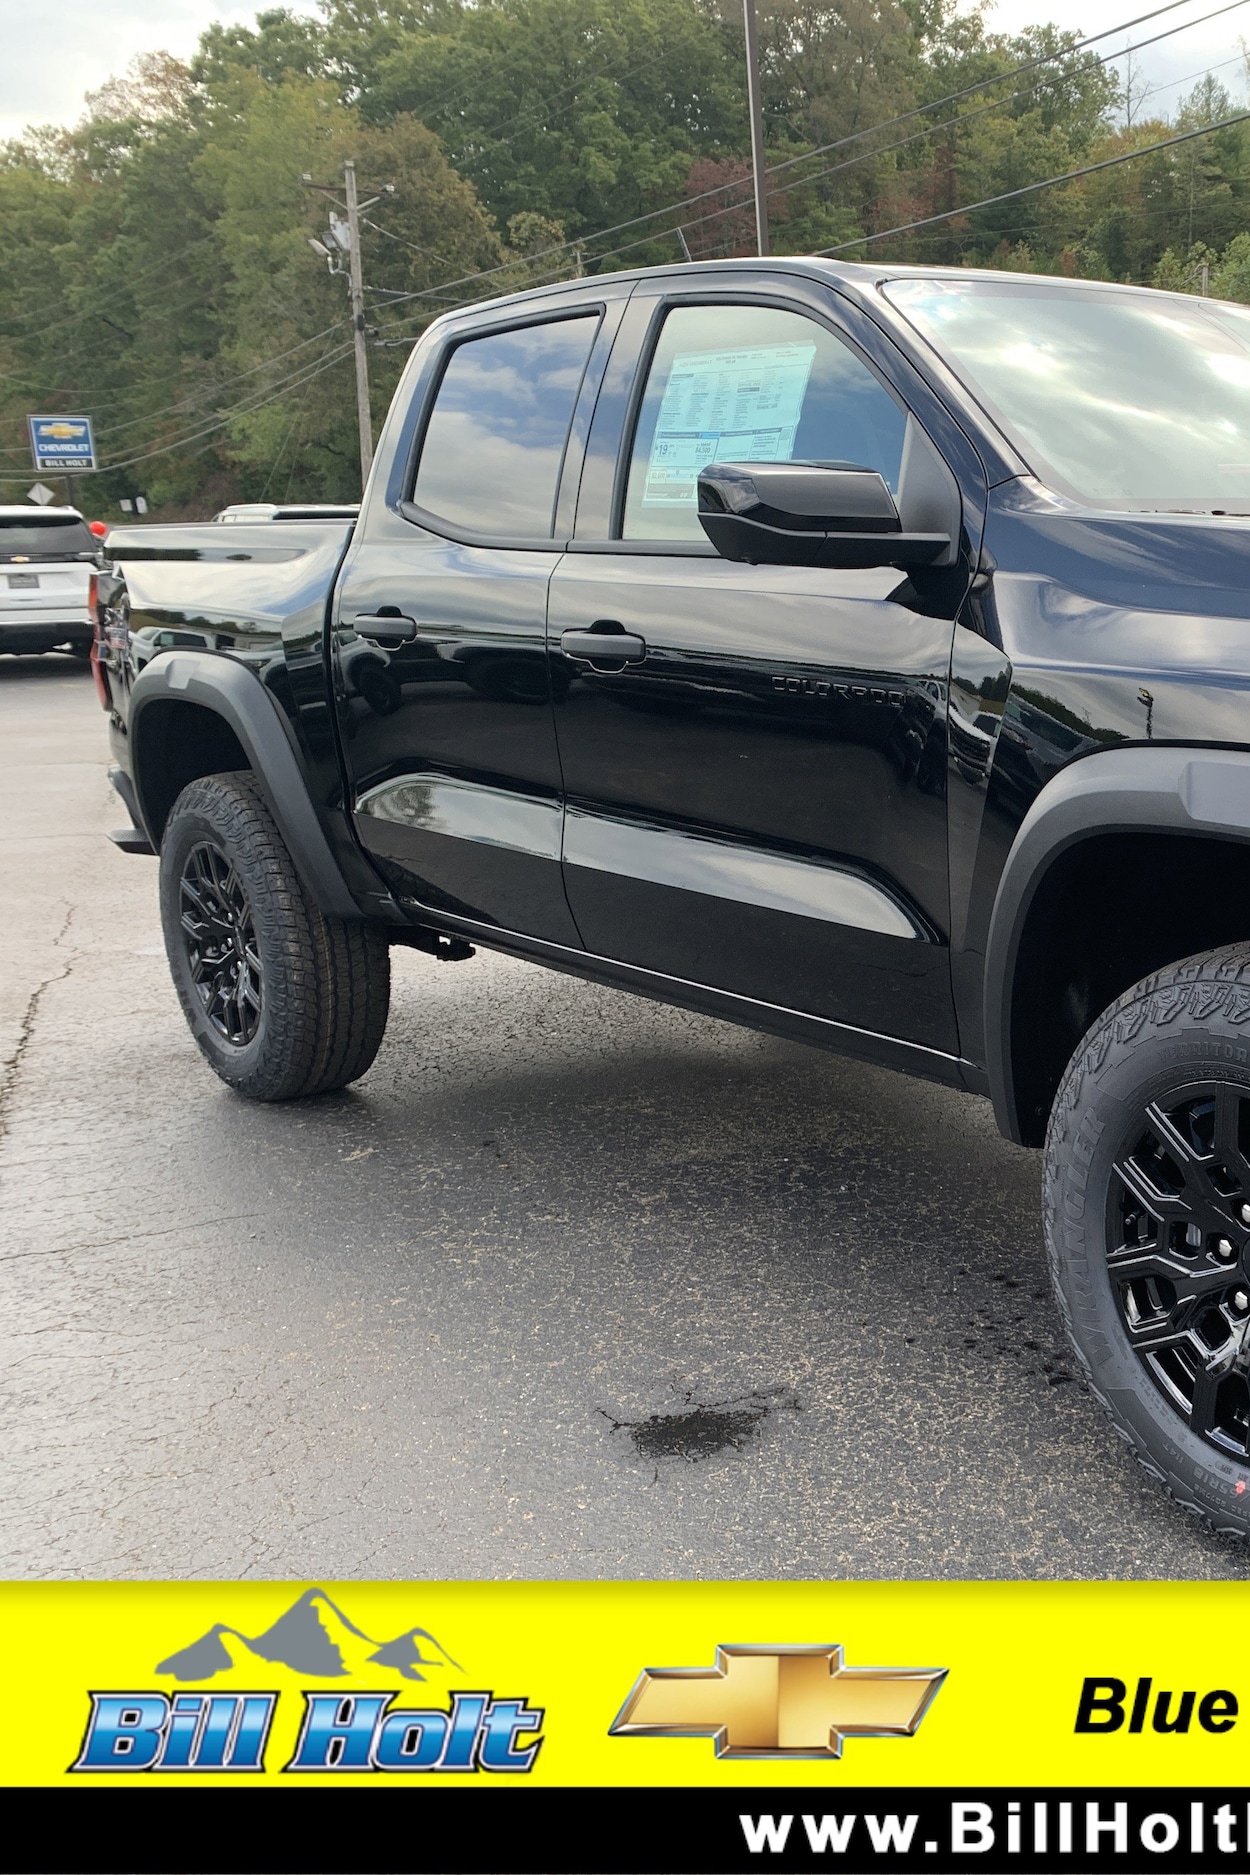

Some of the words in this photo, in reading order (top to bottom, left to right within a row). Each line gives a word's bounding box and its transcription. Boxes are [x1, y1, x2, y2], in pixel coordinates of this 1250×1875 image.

[38, 443, 90, 453] CHEVROLET
[771, 676, 907, 707] COLORADO
[1063, 1107, 1114, 1366] WRANGLER
